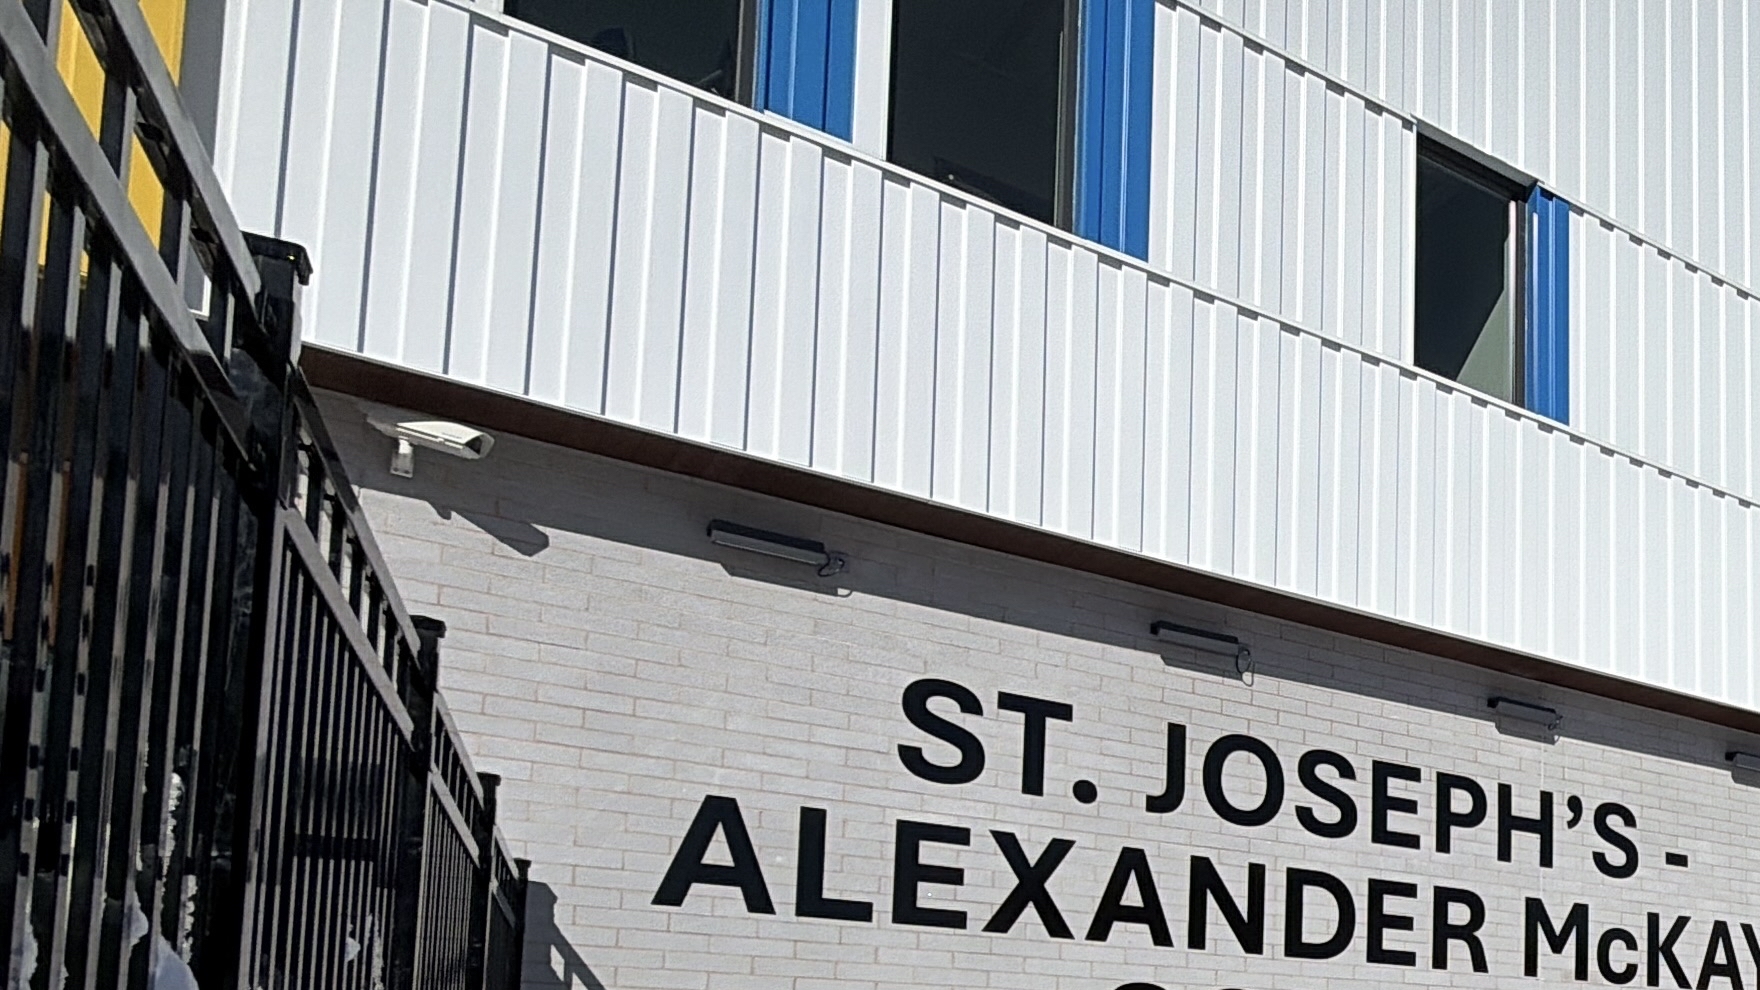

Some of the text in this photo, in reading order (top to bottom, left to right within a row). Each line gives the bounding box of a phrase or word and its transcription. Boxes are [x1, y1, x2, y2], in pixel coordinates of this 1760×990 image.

[897, 678, 1098, 804] ST.
[1145, 721, 1639, 879] JOSEPH’S
[650, 794, 1489, 974] ALEXANDER
